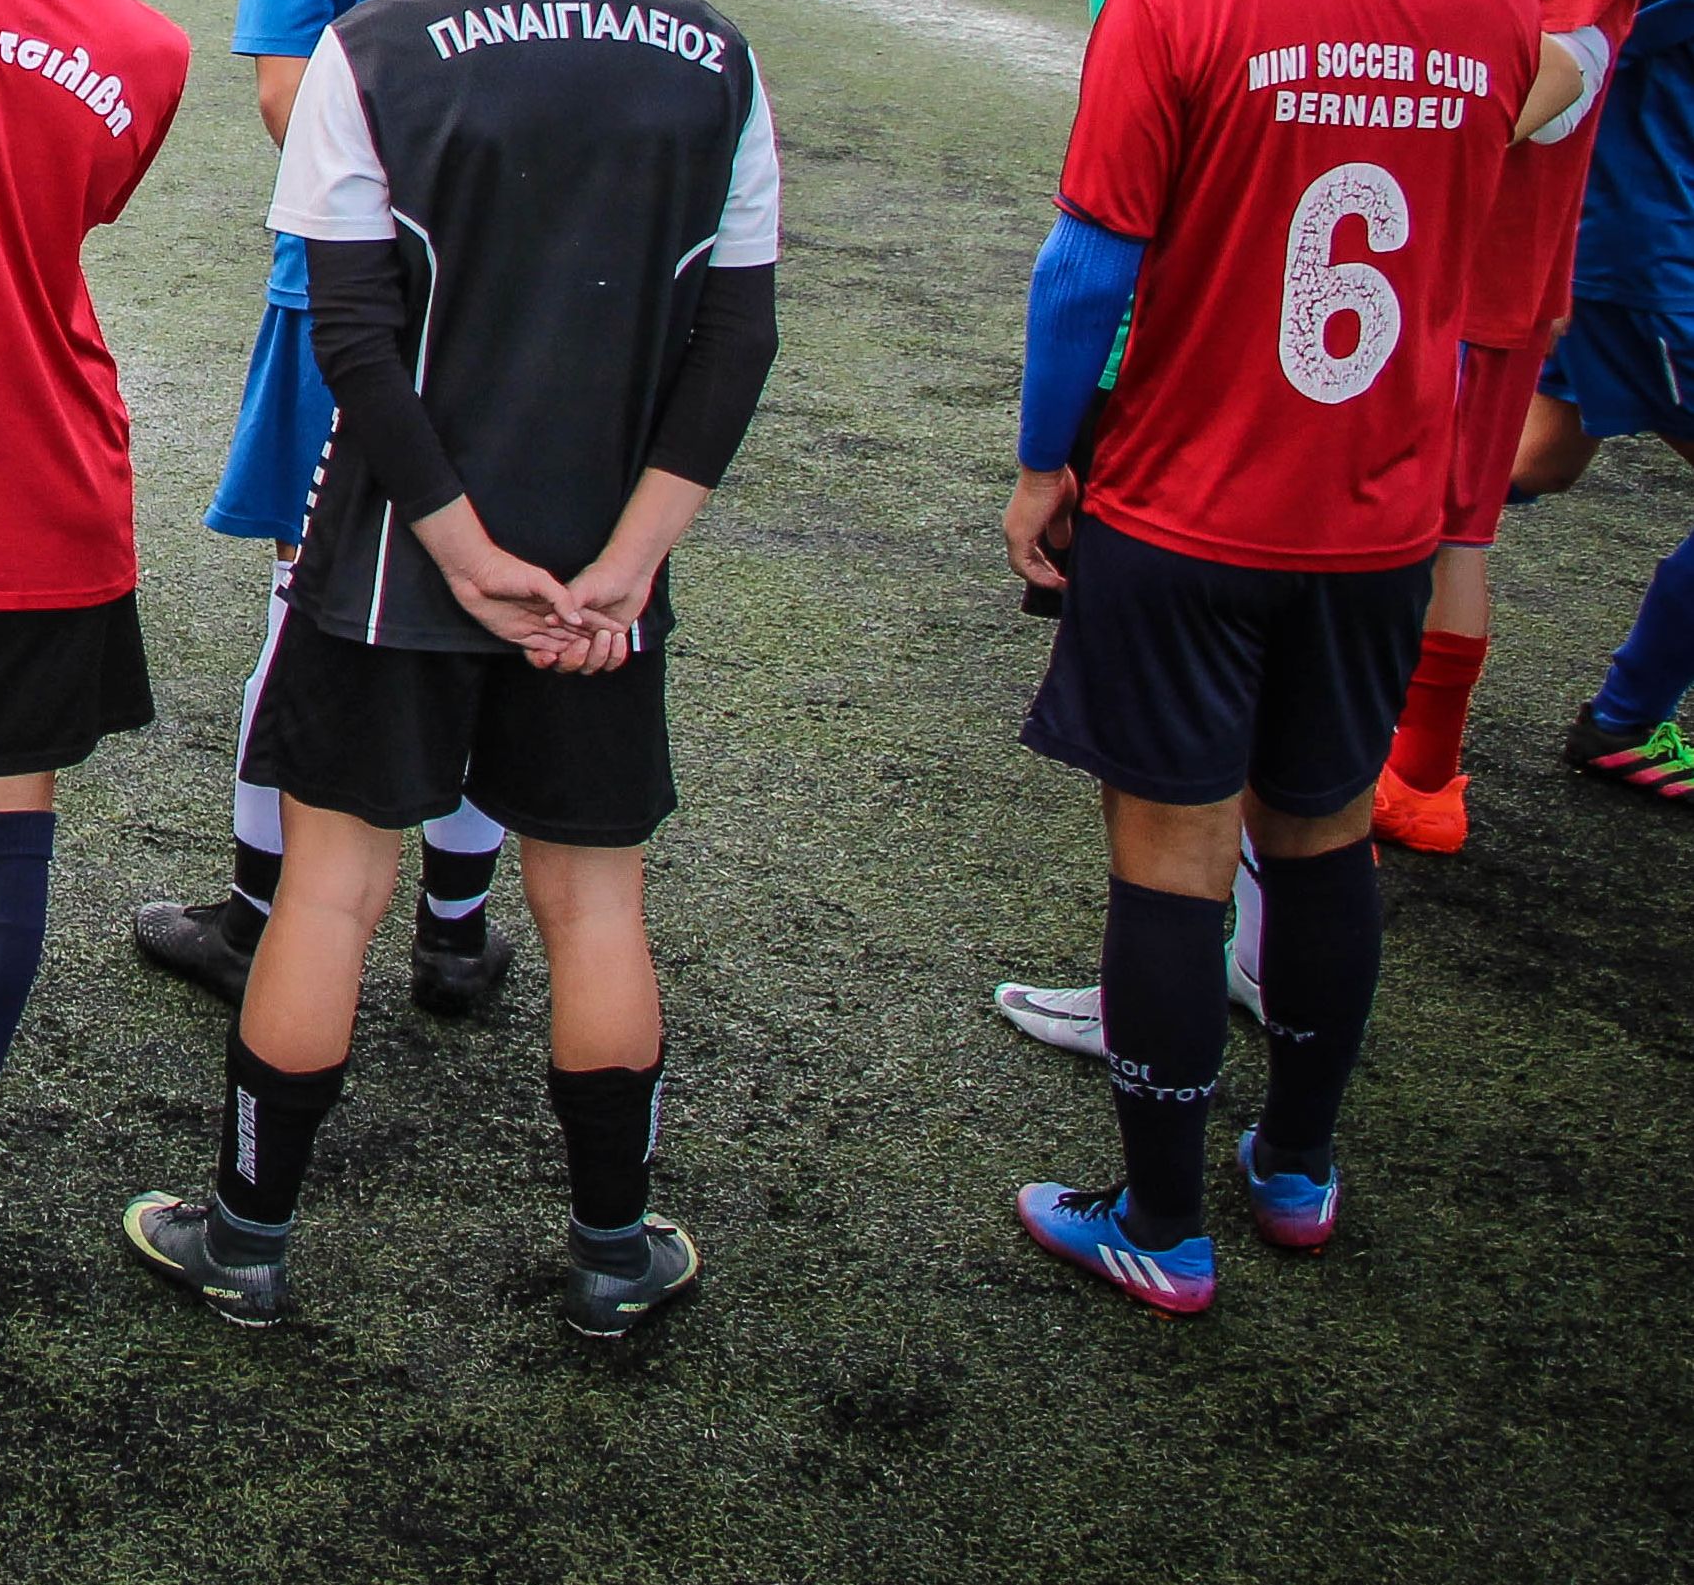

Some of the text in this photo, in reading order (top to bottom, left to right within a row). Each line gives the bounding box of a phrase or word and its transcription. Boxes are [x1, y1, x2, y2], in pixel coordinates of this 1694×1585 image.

[427, 3, 726, 74] ΠΑΝΑΙΓΙΑΛΕΙΟΣ
[1249, 42, 1489, 98] MINI SOCCER CLUB
[1275, 91, 1465, 130] BERNABEU
[1278, 162, 1409, 405] 6
